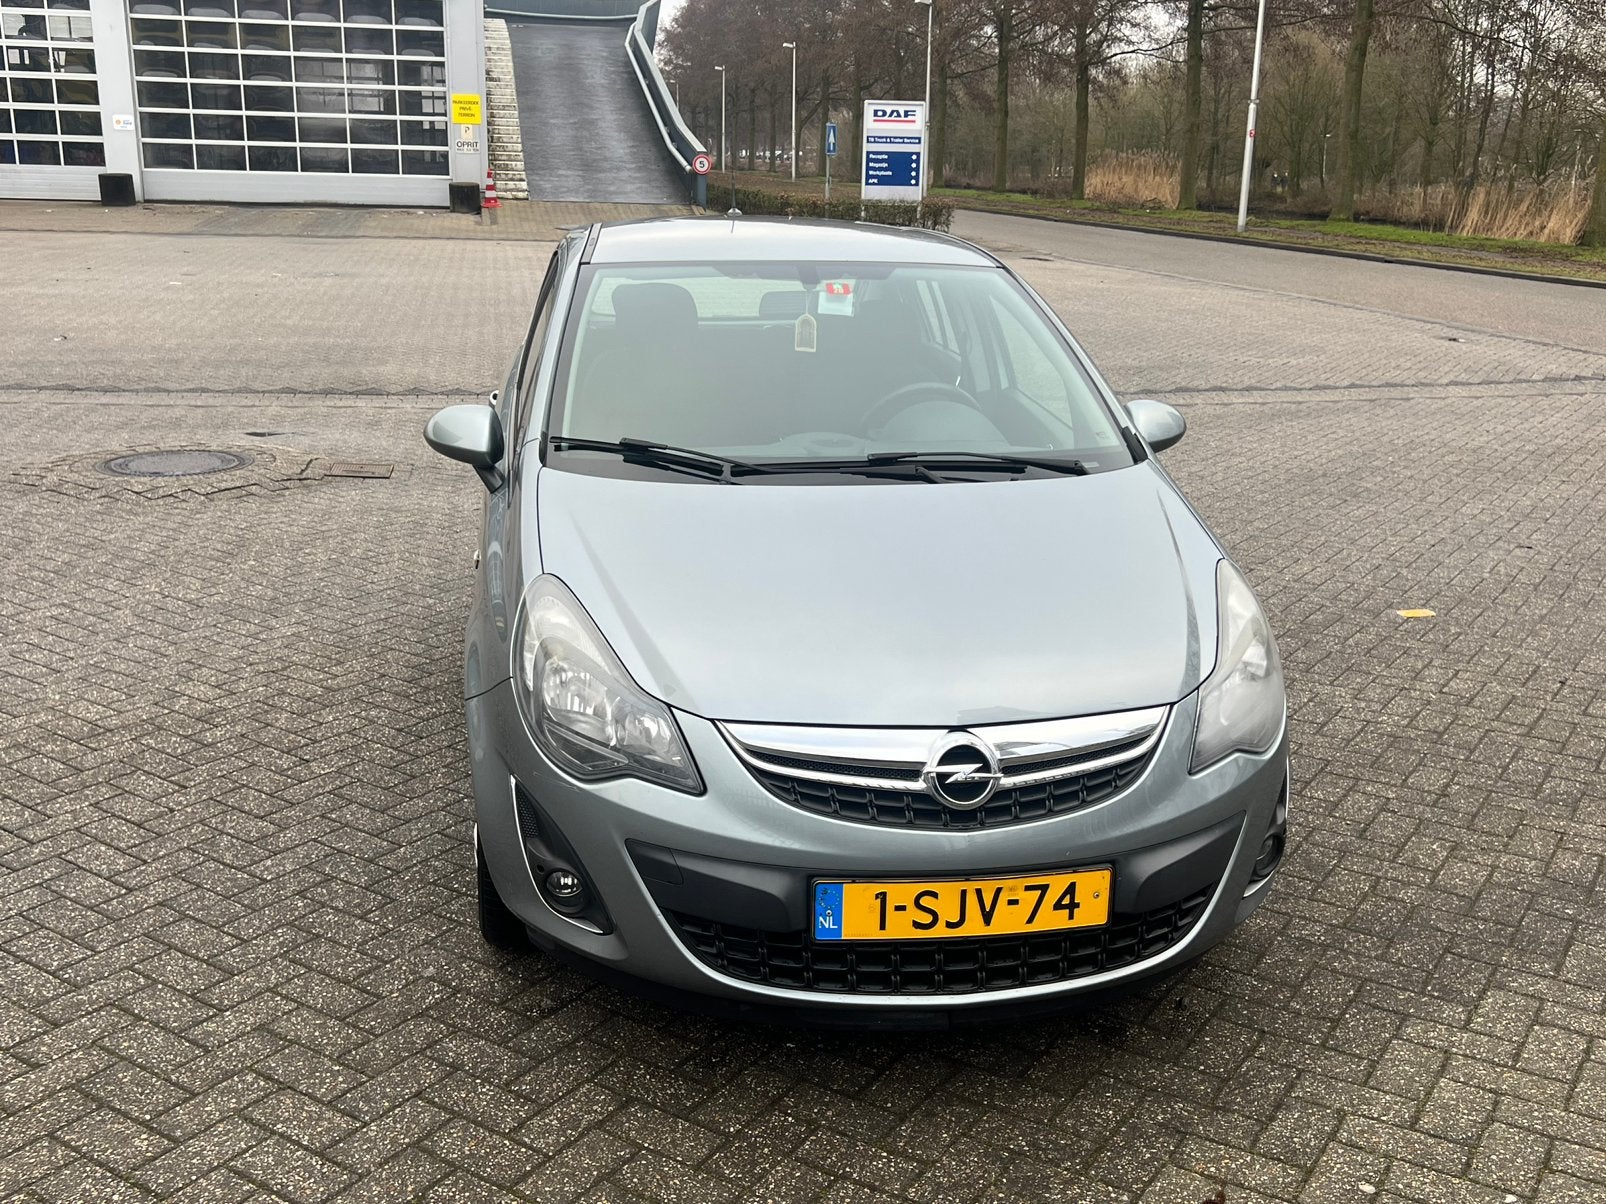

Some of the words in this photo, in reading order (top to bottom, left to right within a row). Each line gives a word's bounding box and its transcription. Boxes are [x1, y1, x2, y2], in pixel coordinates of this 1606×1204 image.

[873, 109, 916, 118] DAF
[456, 140, 479, 148] OPRIT
[699, 160, 705, 168] 5
[874, 881, 1080, 931] 1-SJV-74
[818, 916, 838, 929] NL
